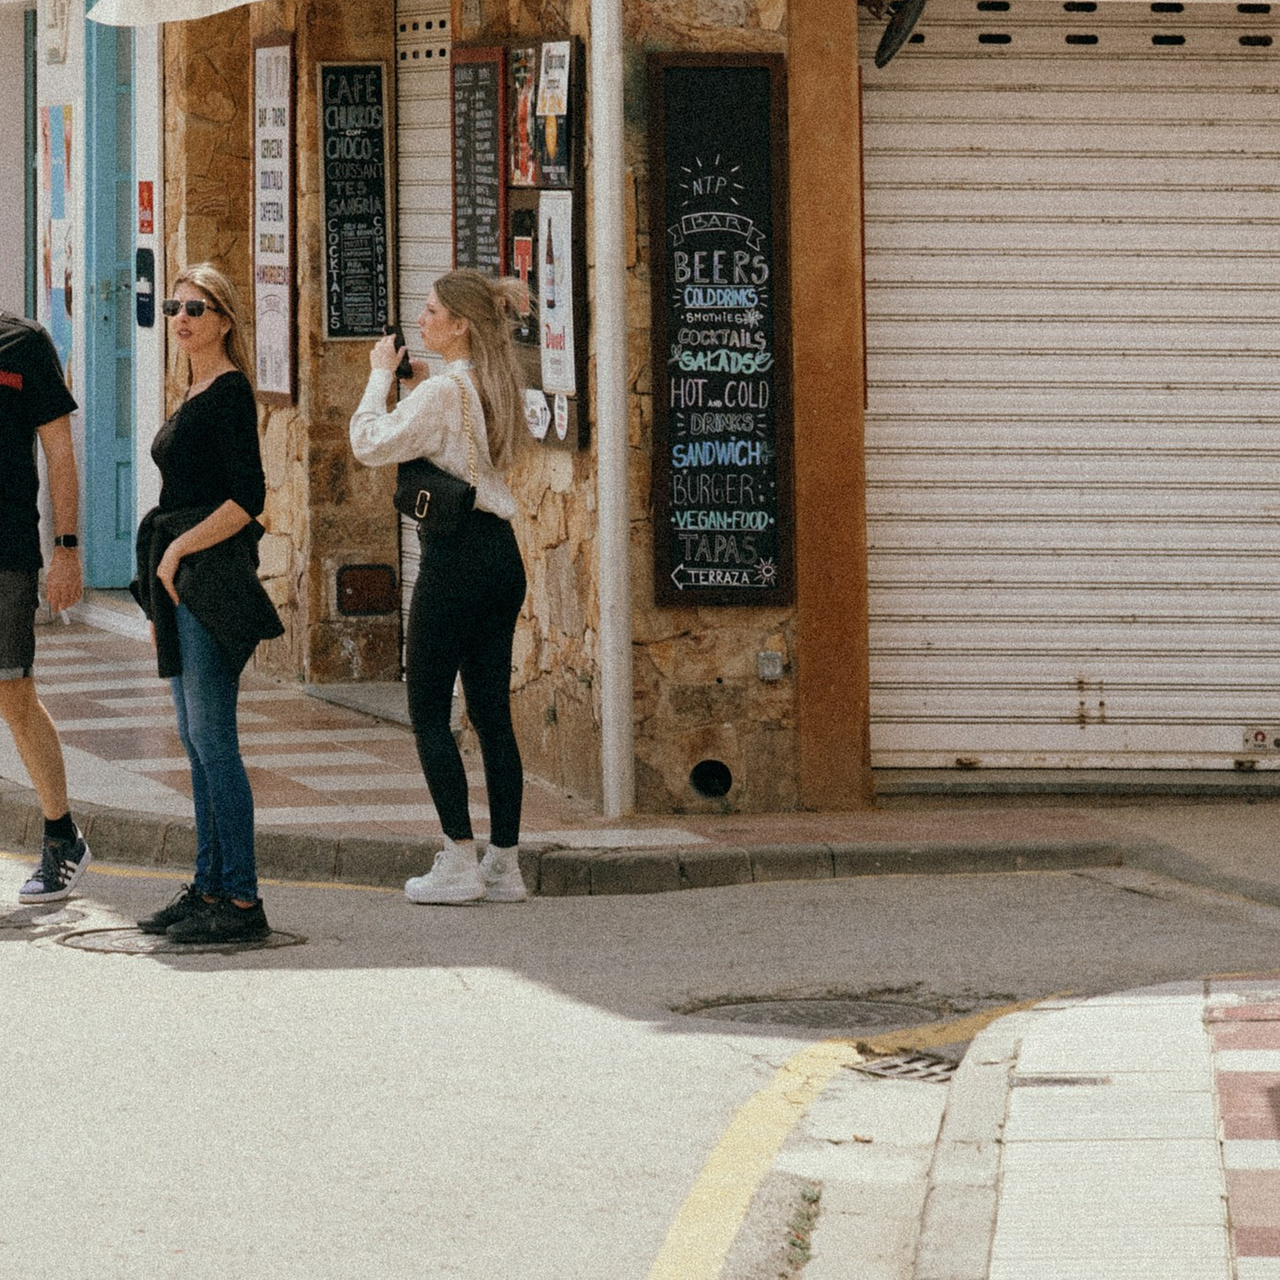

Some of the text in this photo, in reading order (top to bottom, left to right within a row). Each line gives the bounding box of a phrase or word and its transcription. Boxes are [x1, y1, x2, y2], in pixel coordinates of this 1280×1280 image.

[325, 70, 377, 104] CAFÉ
[326, 137, 371, 160] CHOCO
[691, 215, 741, 230] BAR
[328, 219, 341, 329] COCKTAILS
[674, 250, 769, 284] BEERS
[677, 328, 767, 350] COCKTAILS
[679, 349, 757, 374] SALADS
[671, 378, 708, 408] HOT
[724, 381, 770, 409] COLD
[690, 412, 754, 435] DRINKS
[672, 436, 761, 468] SANDWICH
[673, 473, 756, 505] BURGER
[678, 533, 759, 564] TAPAS
[687, 570, 750, 585] TERRAZA
